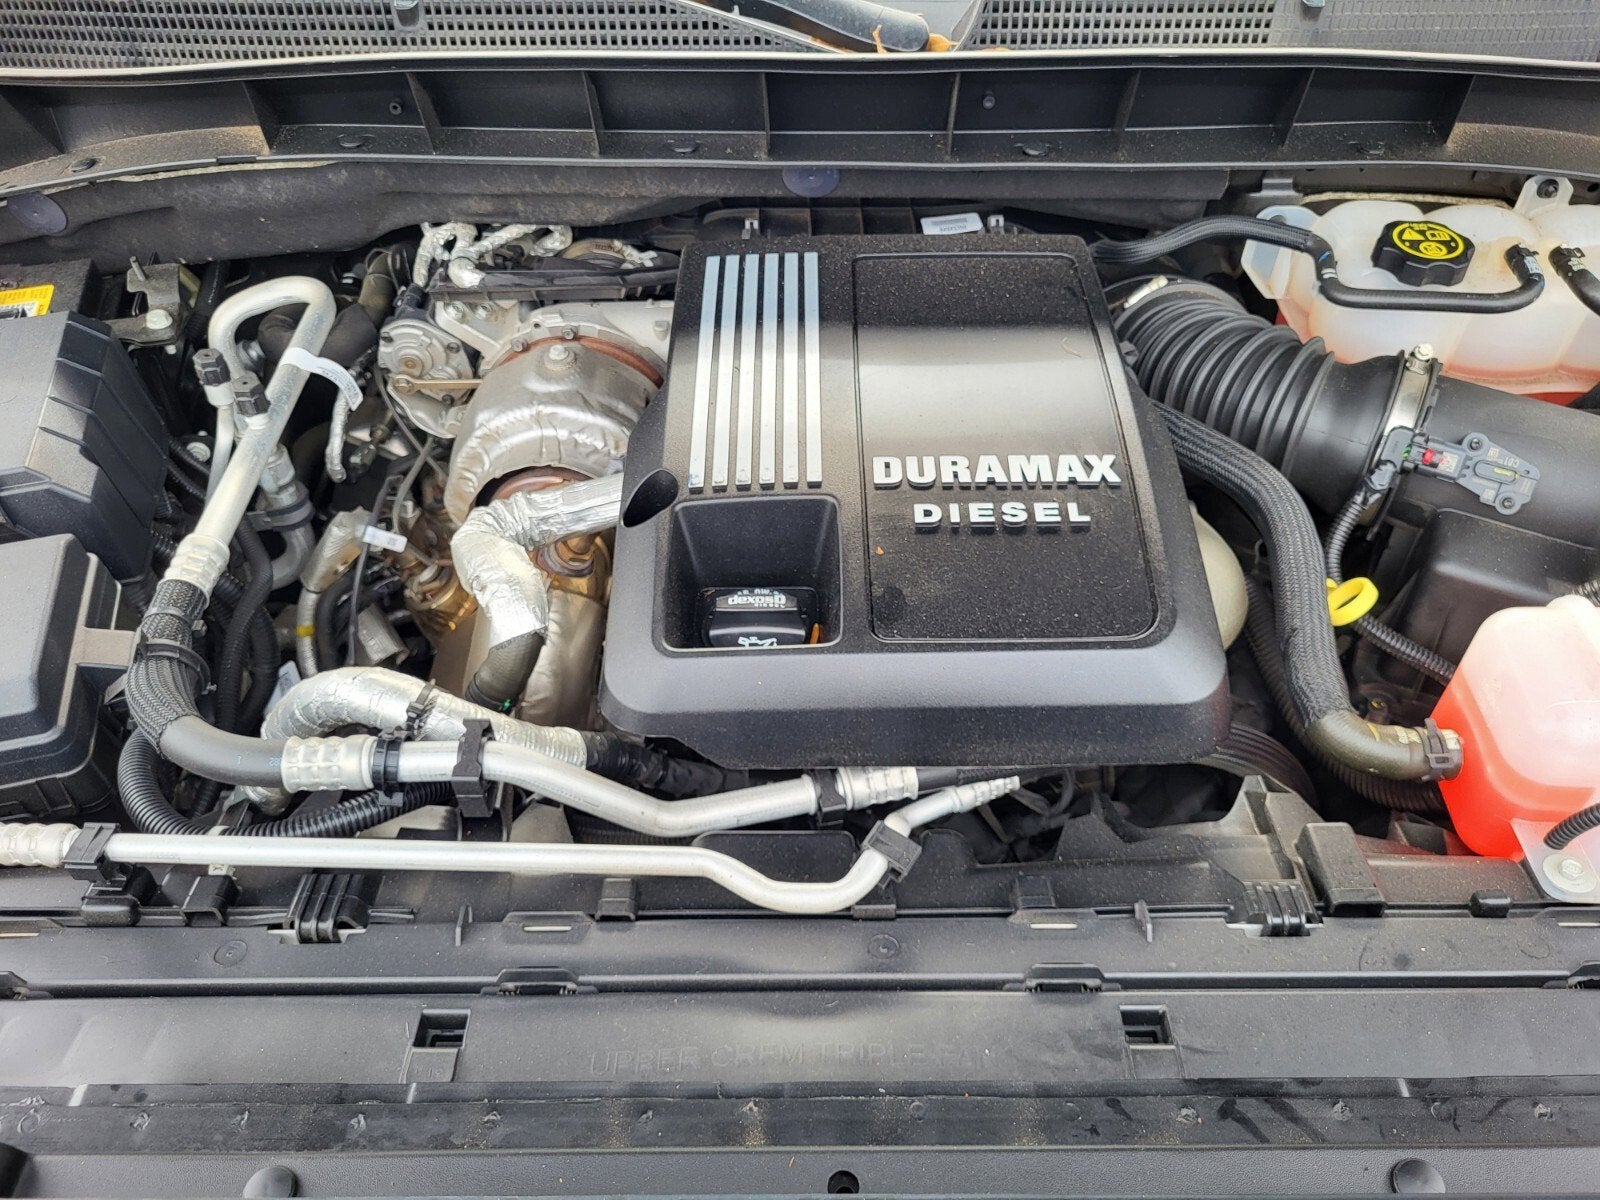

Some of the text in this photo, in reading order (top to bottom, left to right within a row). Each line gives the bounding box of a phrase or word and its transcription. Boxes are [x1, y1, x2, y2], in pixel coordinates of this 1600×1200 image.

[872, 454, 1122, 488] DURAMAX
[913, 501, 1092, 526] DIESEL
[589, 1045, 701, 1076] UPPER
[815, 1042, 926, 1067] TRIPLE
